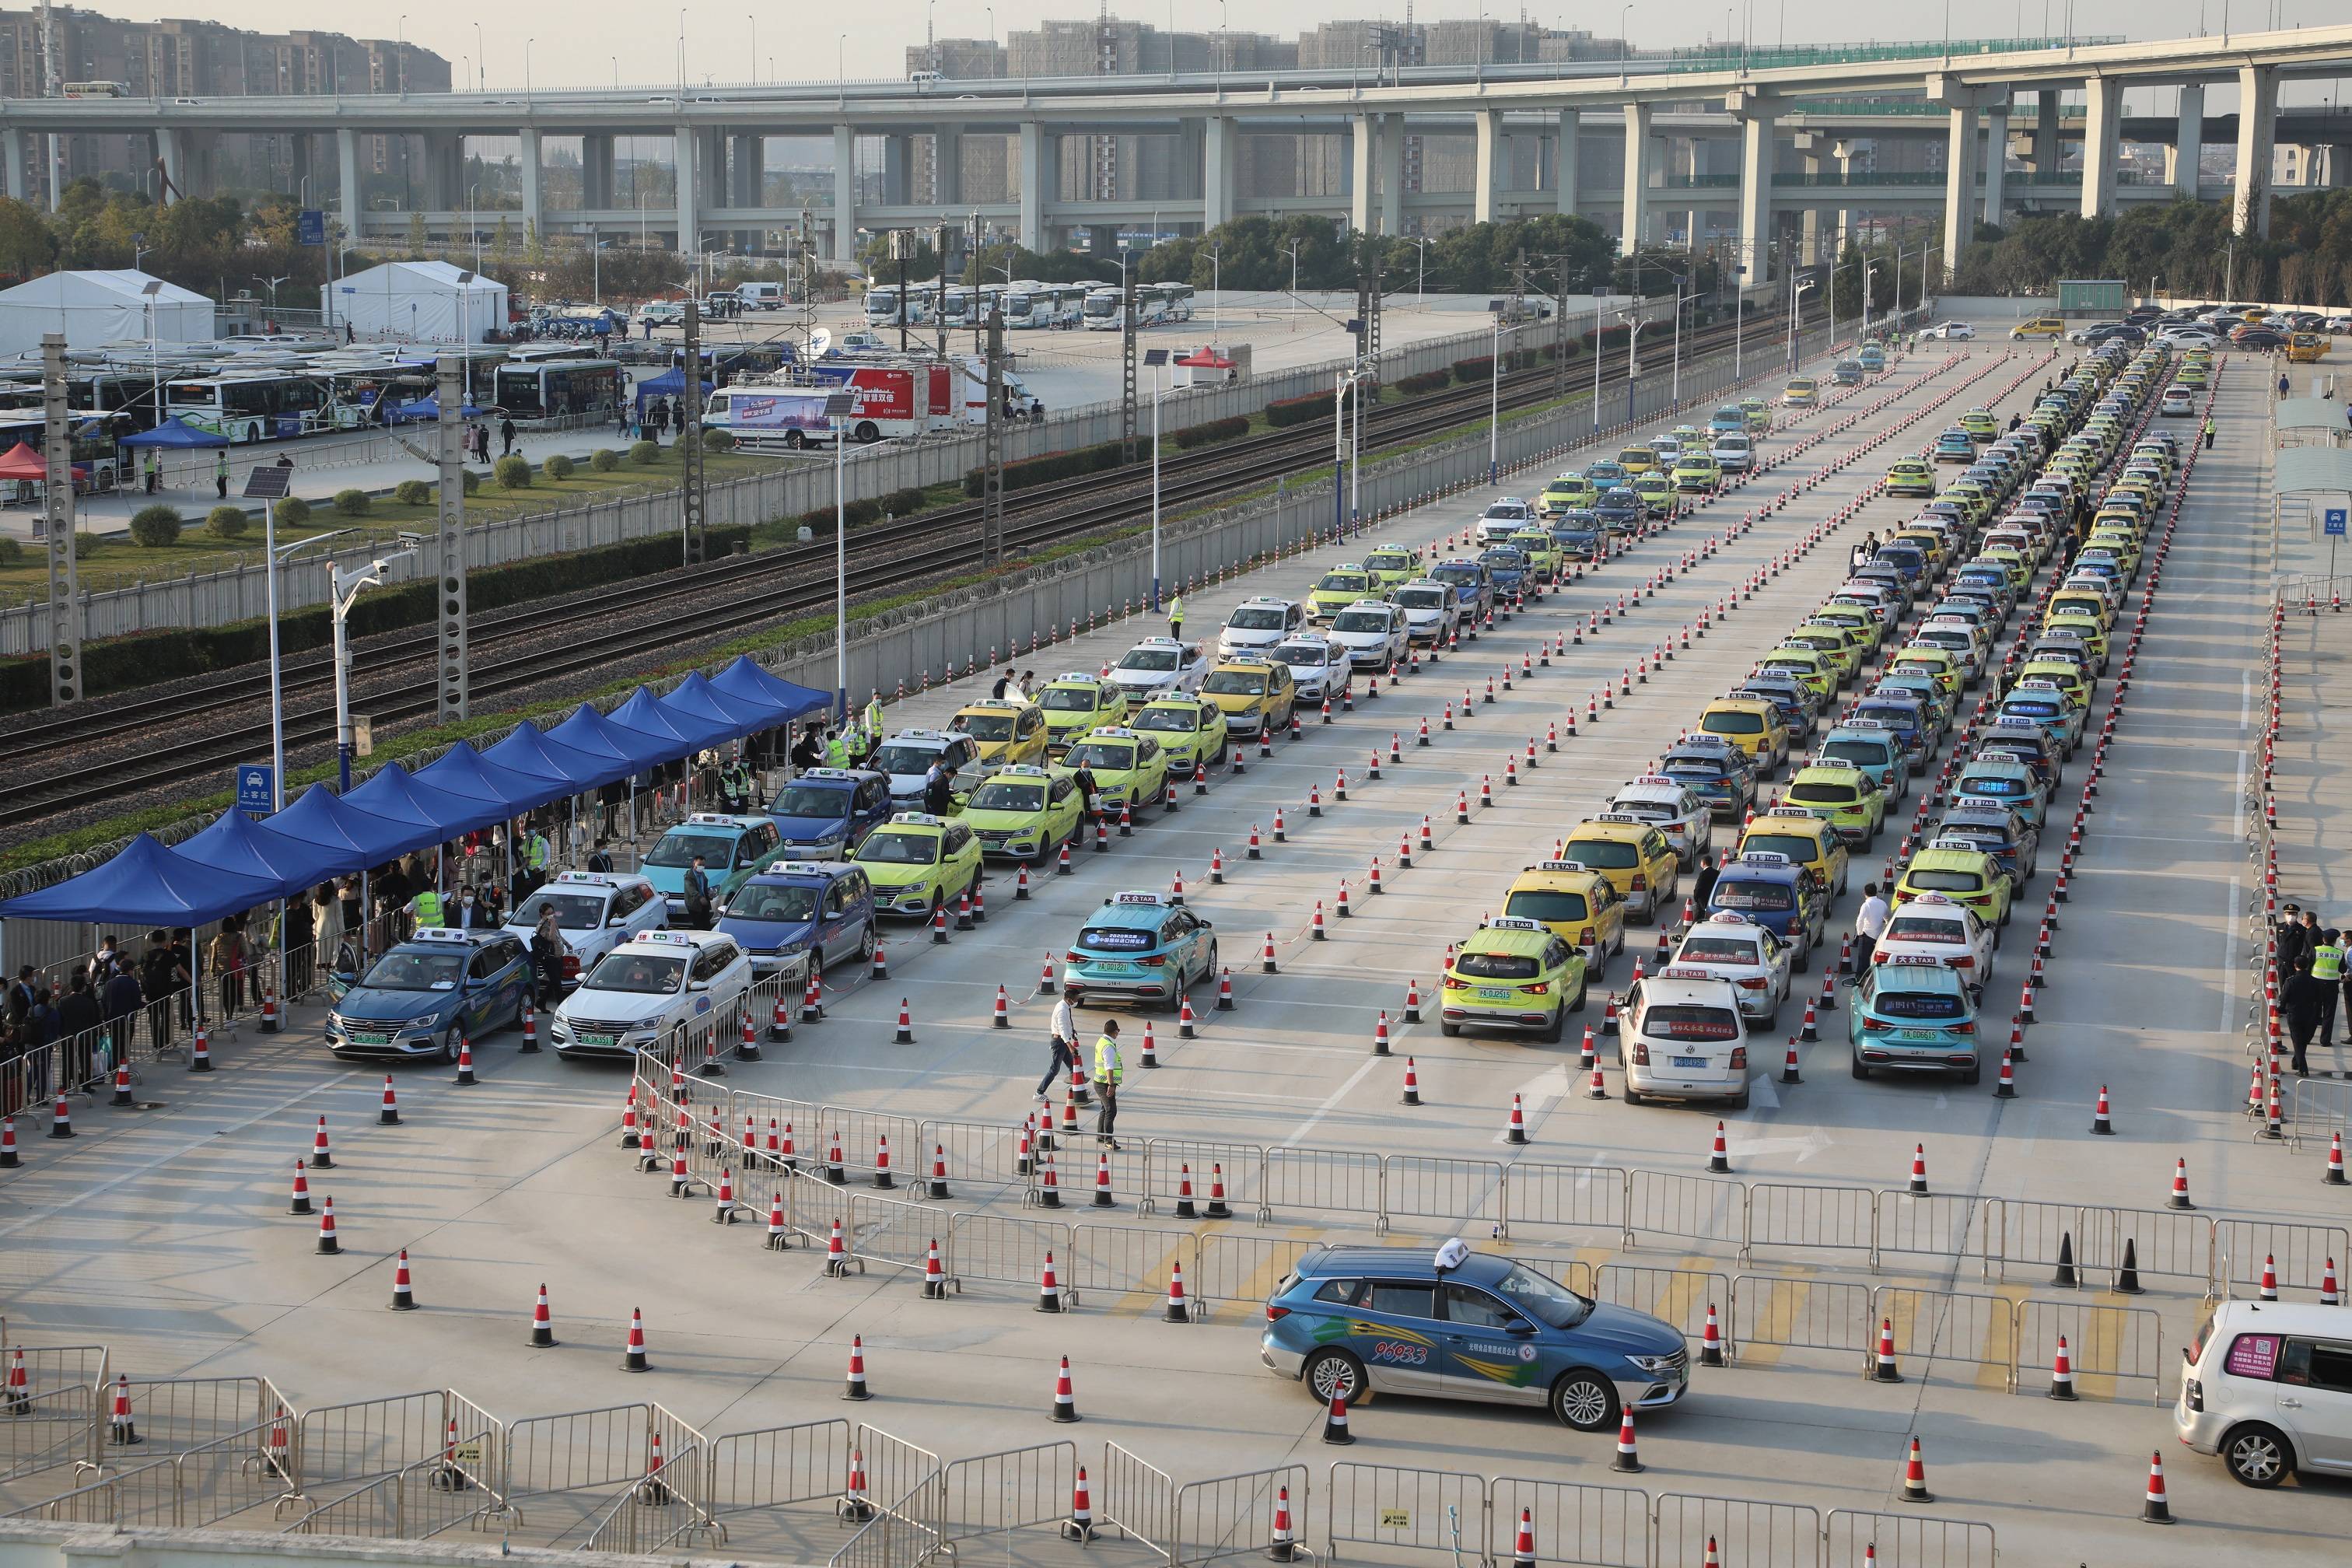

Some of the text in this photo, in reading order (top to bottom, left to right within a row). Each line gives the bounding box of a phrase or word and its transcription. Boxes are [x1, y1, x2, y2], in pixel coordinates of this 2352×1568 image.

[863, 394, 894, 402] 智慧双倍
[241, 789, 268, 800] 上客区
[1498, 920, 1532, 929] 强生TAXI
[1669, 968, 1706, 978] 锦江TAXI
[1489, 990, 1510, 999] DJ2515
[592, 1035, 613, 1045] DK3517
[1913, 1031, 1936, 1039] DD6615
[1372, 1341, 1428, 1365] 96933
[1468, 1343, 1517, 1356] 光明食品集团成员企业
